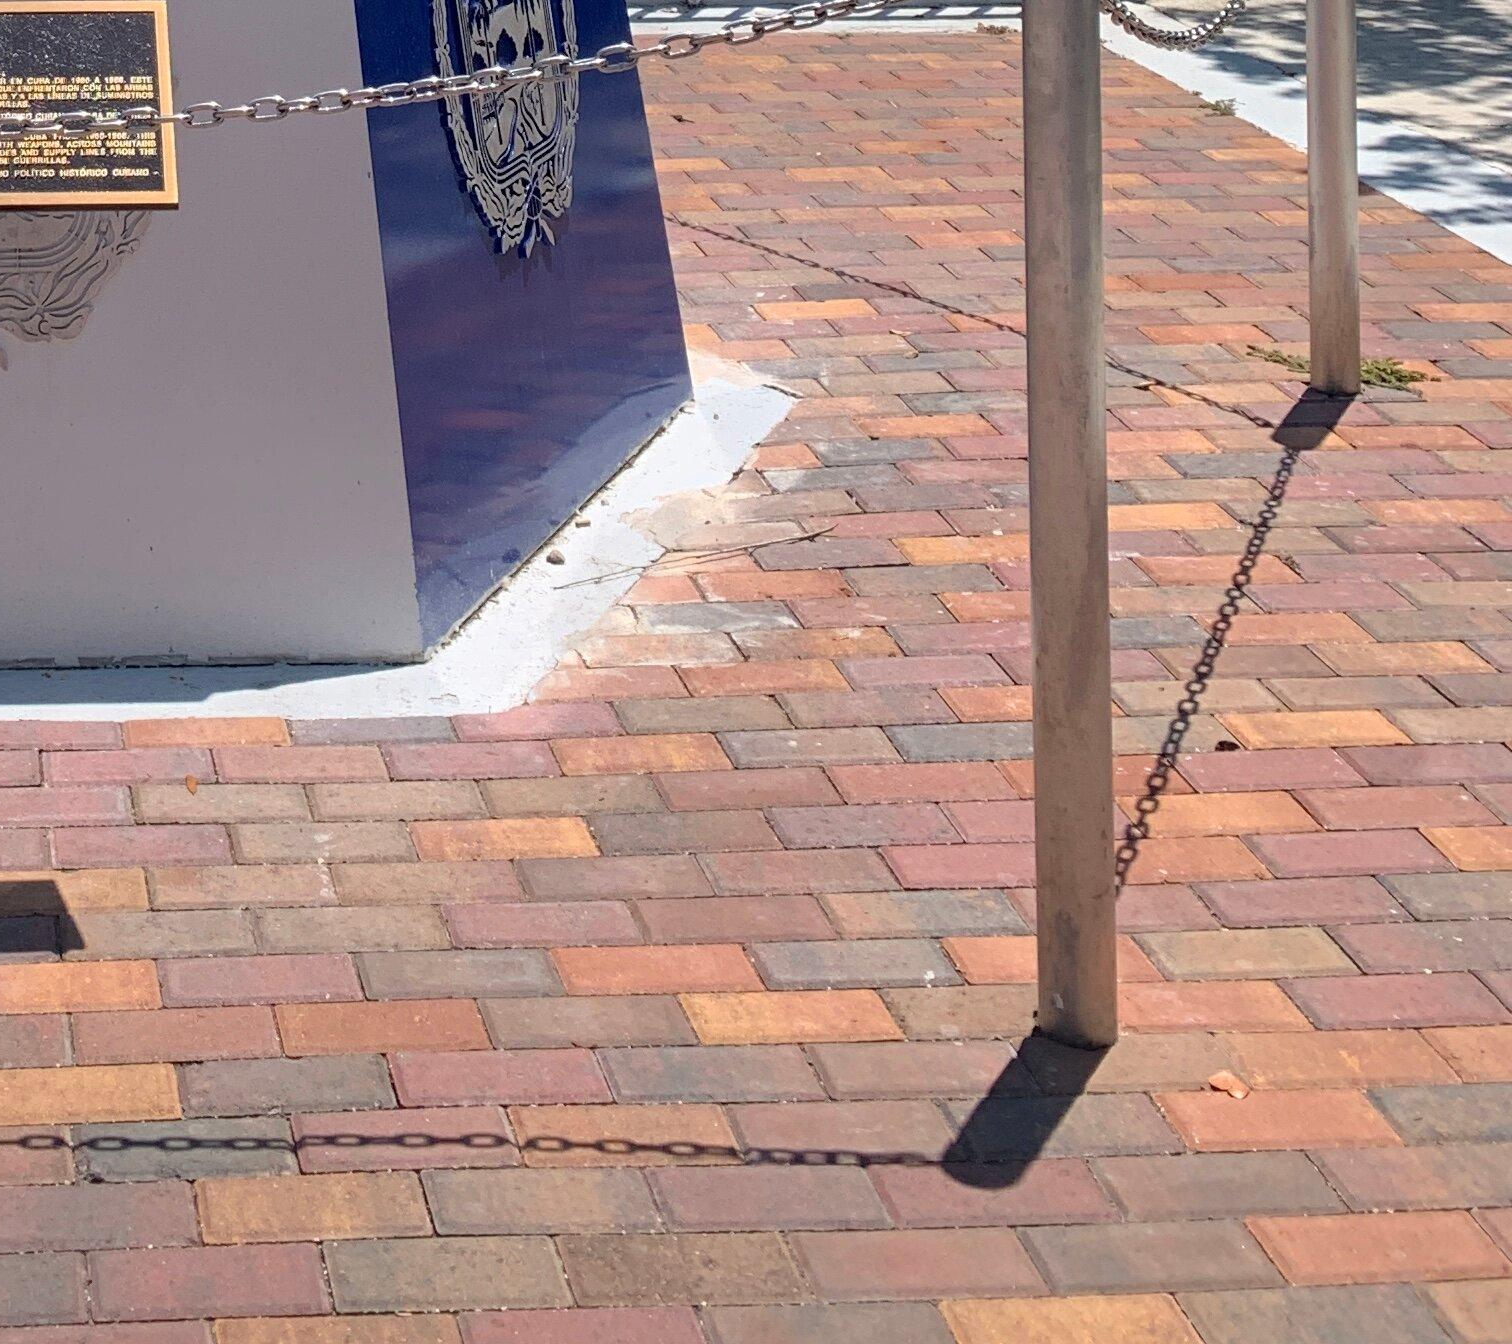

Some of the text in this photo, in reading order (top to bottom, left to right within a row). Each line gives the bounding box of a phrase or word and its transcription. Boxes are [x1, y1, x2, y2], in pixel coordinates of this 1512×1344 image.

[130, 76, 153, 84] ESTE
[123, 84, 153, 92] ARMAS
[66, 141, 102, 149] ACROSS
[105, 140, 156, 148] MOUNTAINS
[21, 149, 39, 157] AND
[43, 149, 76, 157] SUPPLY
[110, 148, 136, 156] FROM
[112, 169, 149, 177] CUBANO
